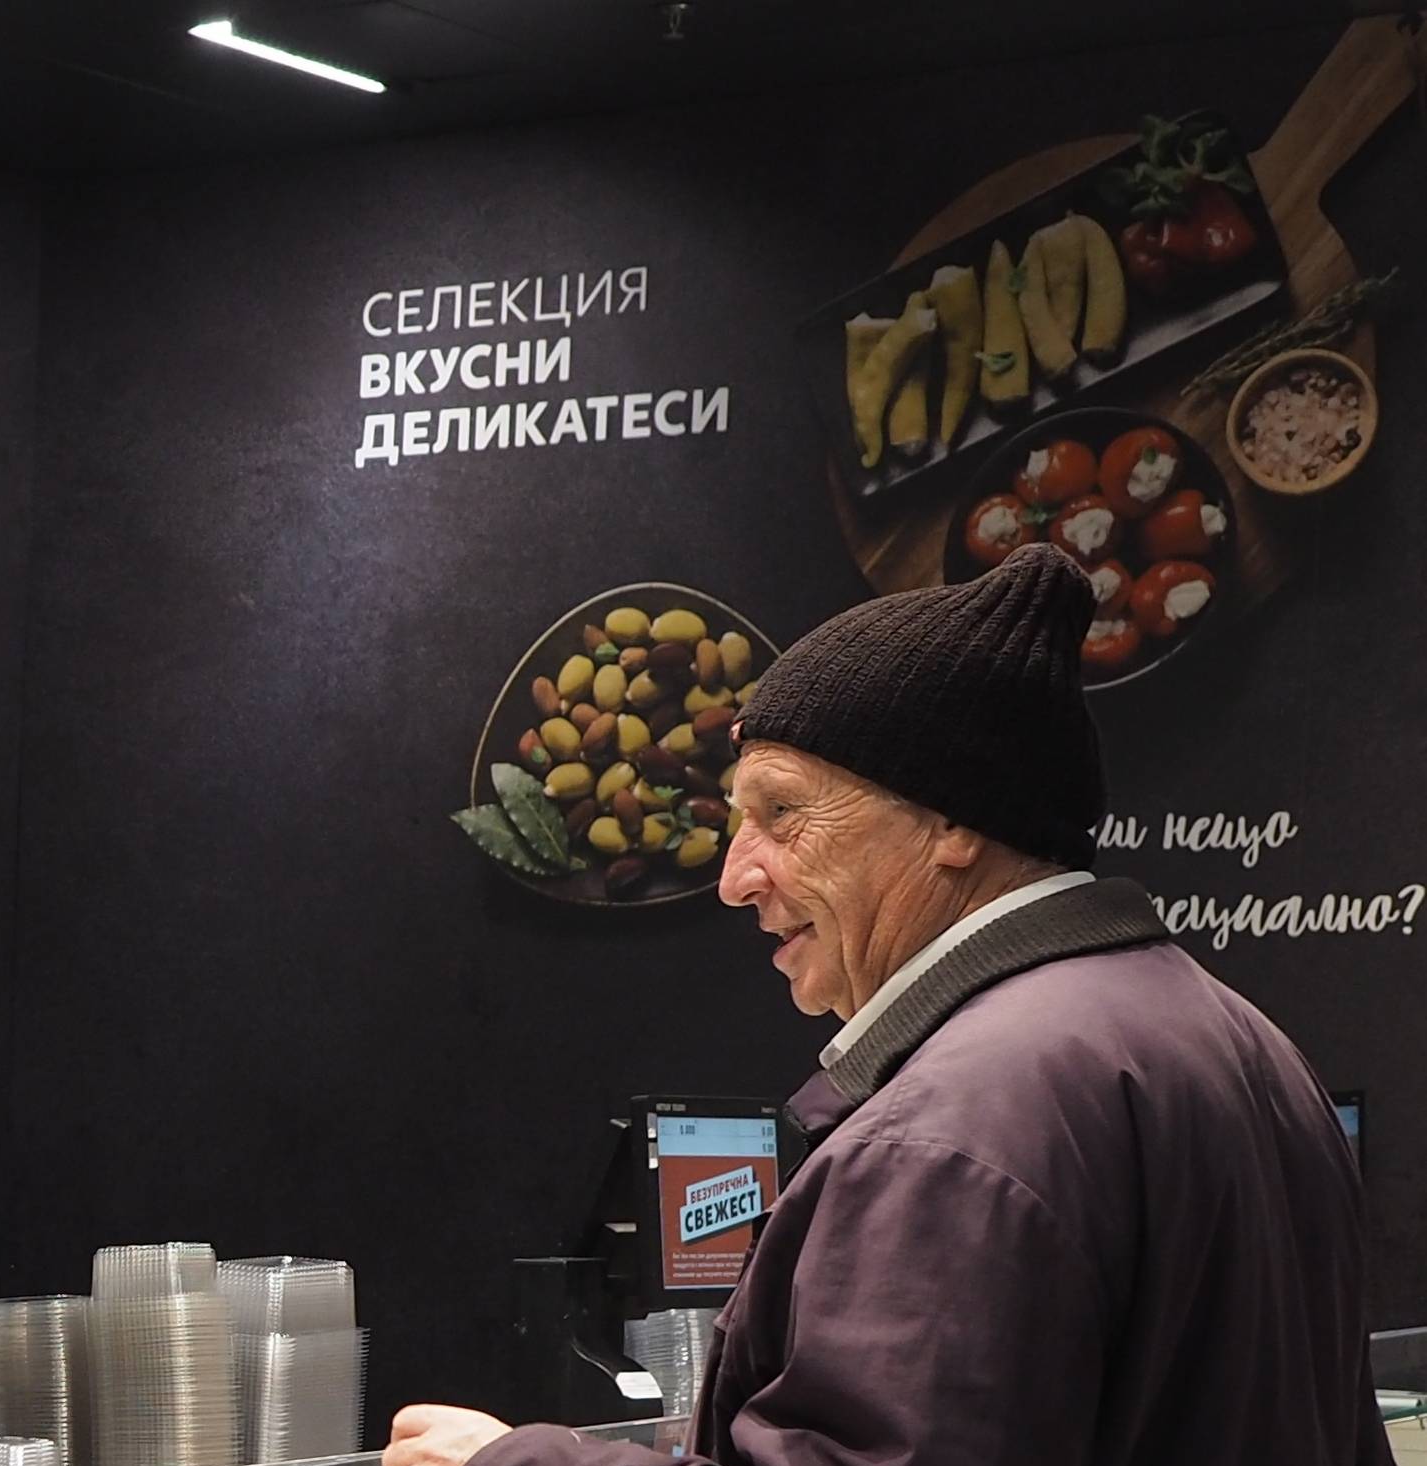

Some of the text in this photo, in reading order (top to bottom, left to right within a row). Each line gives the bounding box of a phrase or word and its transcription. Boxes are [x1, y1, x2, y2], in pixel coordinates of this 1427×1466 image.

[363, 268, 646, 337] СЕЛЕКЦИЯ
[360, 337, 570, 398] ВКУСНИ
[355, 380, 727, 468] ДЕЛИКАТЕСИ
[1163, 811, 1298, 868] нещо
[685, 1191, 756, 1233] СВЕЖЕСТ
[690, 1174, 749, 1203] БЕЗУПРЕЧНА
